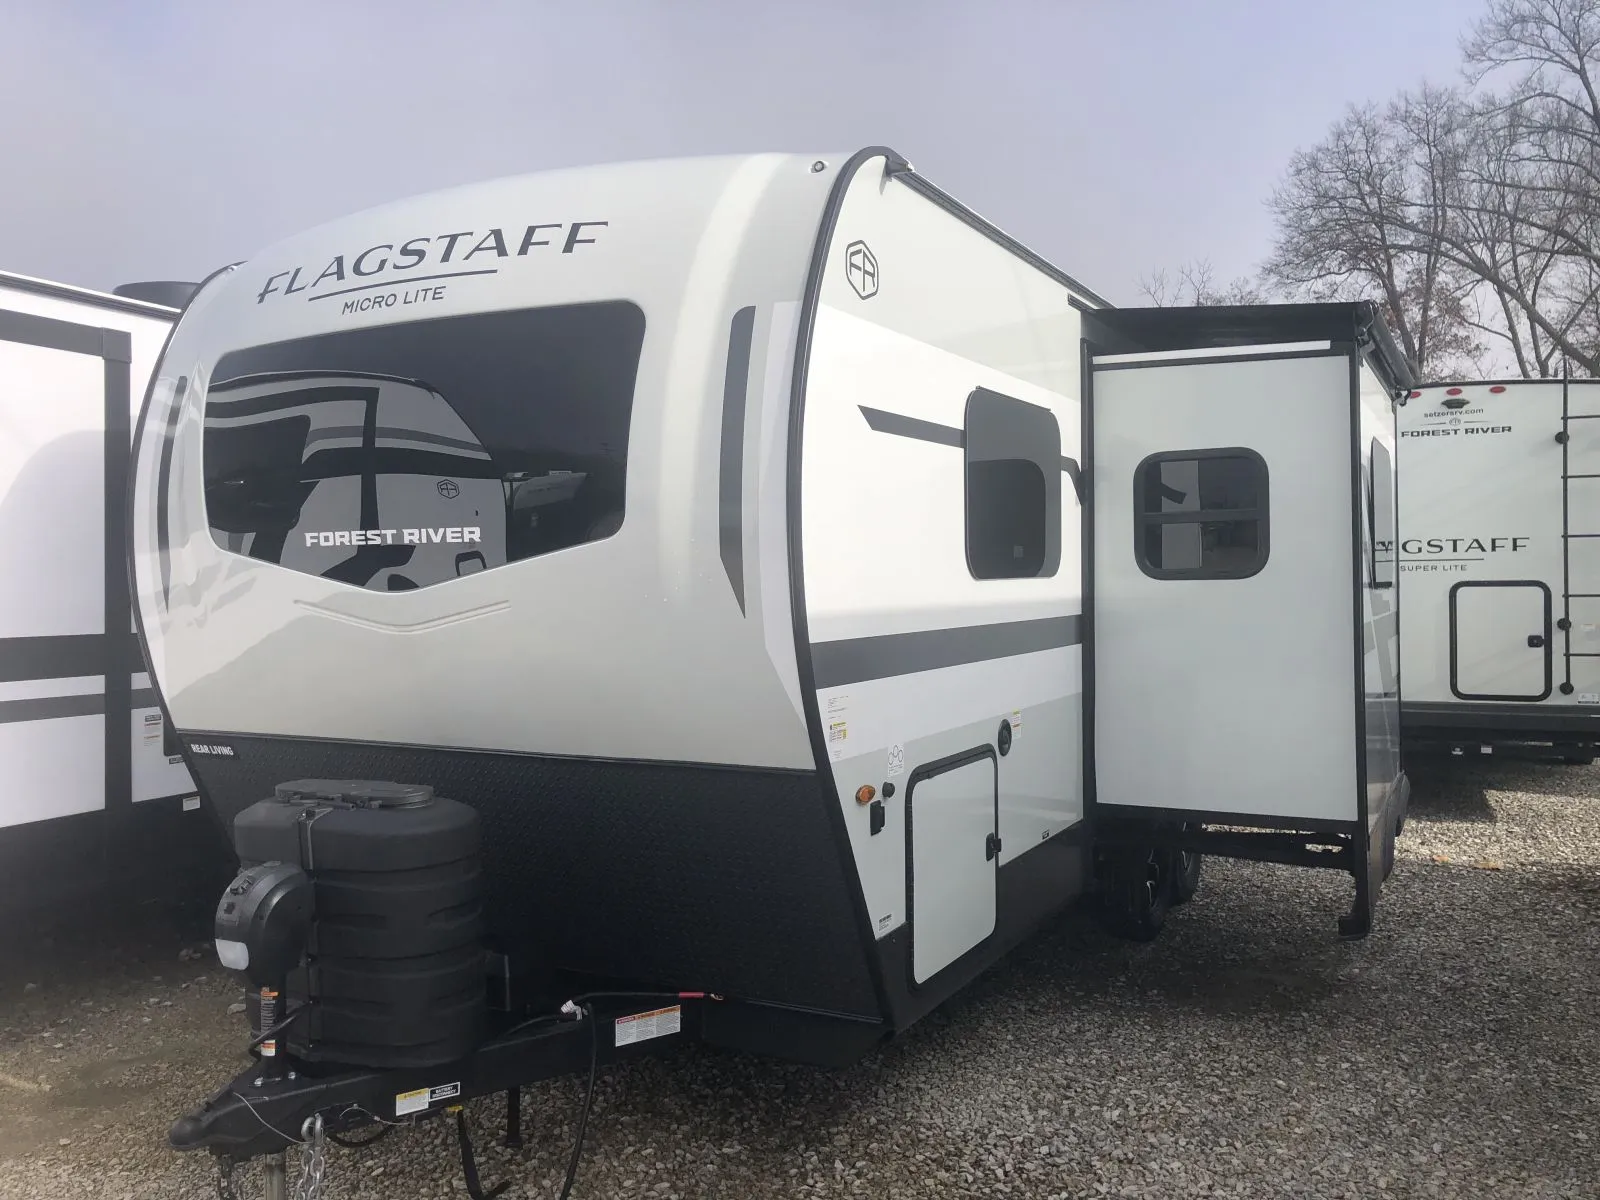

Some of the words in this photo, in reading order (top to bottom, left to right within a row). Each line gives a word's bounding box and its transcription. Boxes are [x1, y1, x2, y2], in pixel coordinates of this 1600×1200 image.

[257, 221, 608, 304] FLAGSTAFF
[342, 293, 397, 314] MICRO
[403, 286, 446, 304] LITE
[1401, 428, 1461, 438] FOREST
[1464, 426, 1512, 435] RIVER
[305, 529, 397, 547] FOREST
[402, 527, 481, 545] RIVER
[1401, 537, 1530, 554] GSTAFF
[190, 743, 210, 753] REAR
[209, 745, 234, 755] LIVING
